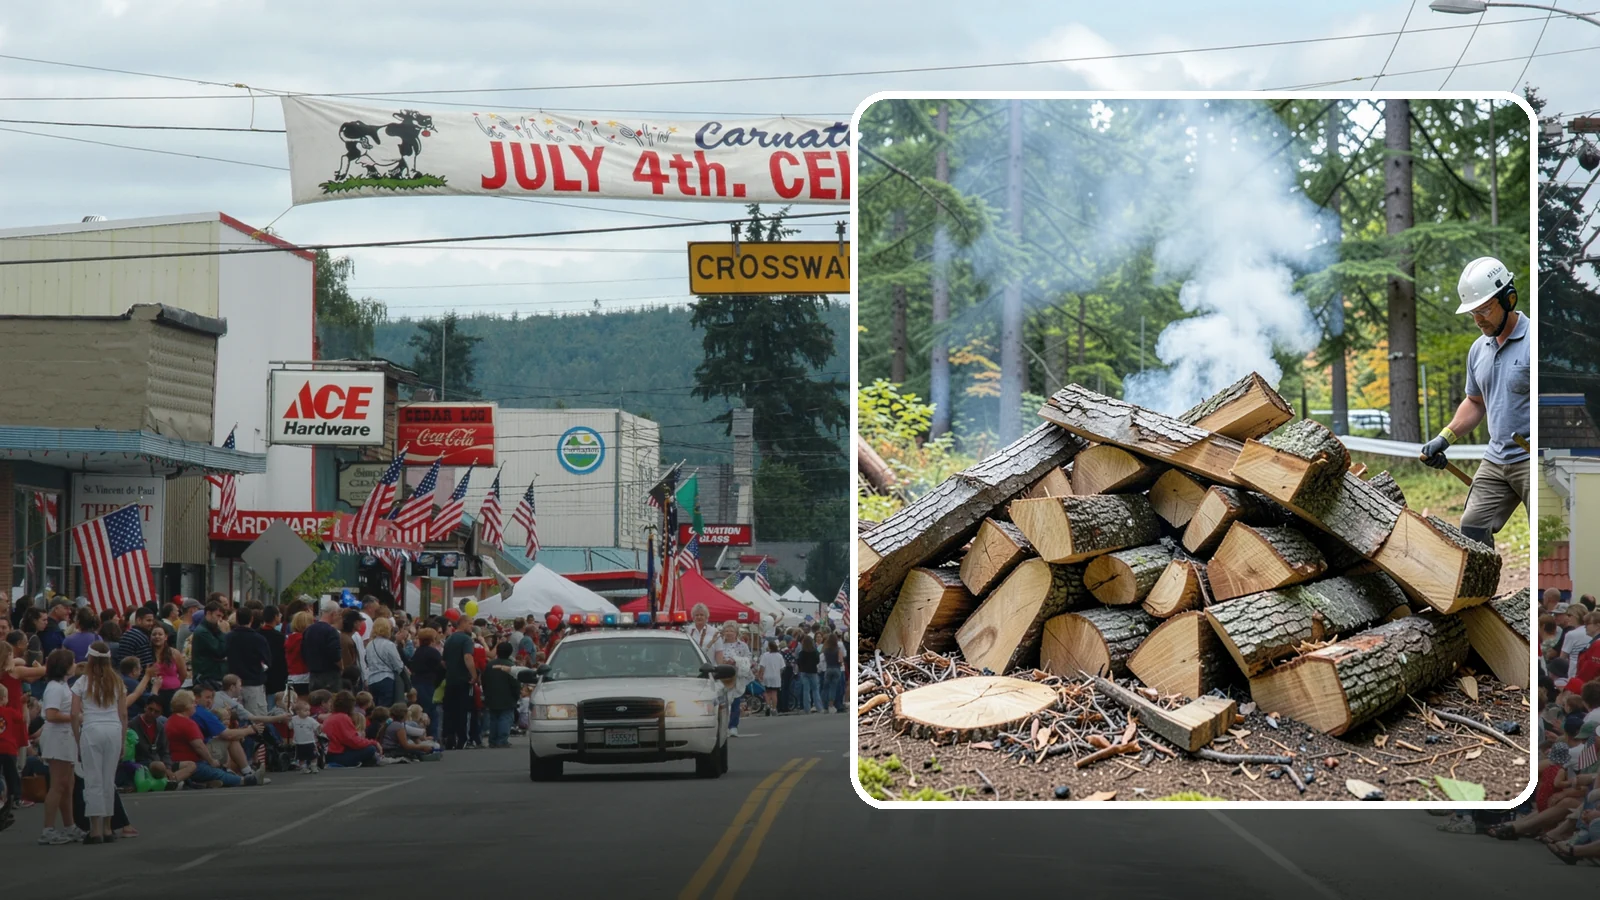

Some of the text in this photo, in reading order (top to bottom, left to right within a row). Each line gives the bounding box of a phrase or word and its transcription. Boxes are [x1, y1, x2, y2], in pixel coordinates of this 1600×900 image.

[481, 141, 605, 193] JULY
[632, 151, 747, 198] 4th.
[697, 254, 850, 280] CROSSWA
[283, 380, 374, 420] ACE
[405, 409, 485, 422] CEDAR LOG
[284, 421, 371, 437] Hardware
[416, 428, 477, 447] Coca-Cola
[354, 467, 386, 481] Simpl
[83, 484, 155, 495] St. Vincent de Paul
[213, 516, 331, 535] HARDARE
[688, 526, 742, 535] CRNATION
[699, 535, 730, 543] GLASS
